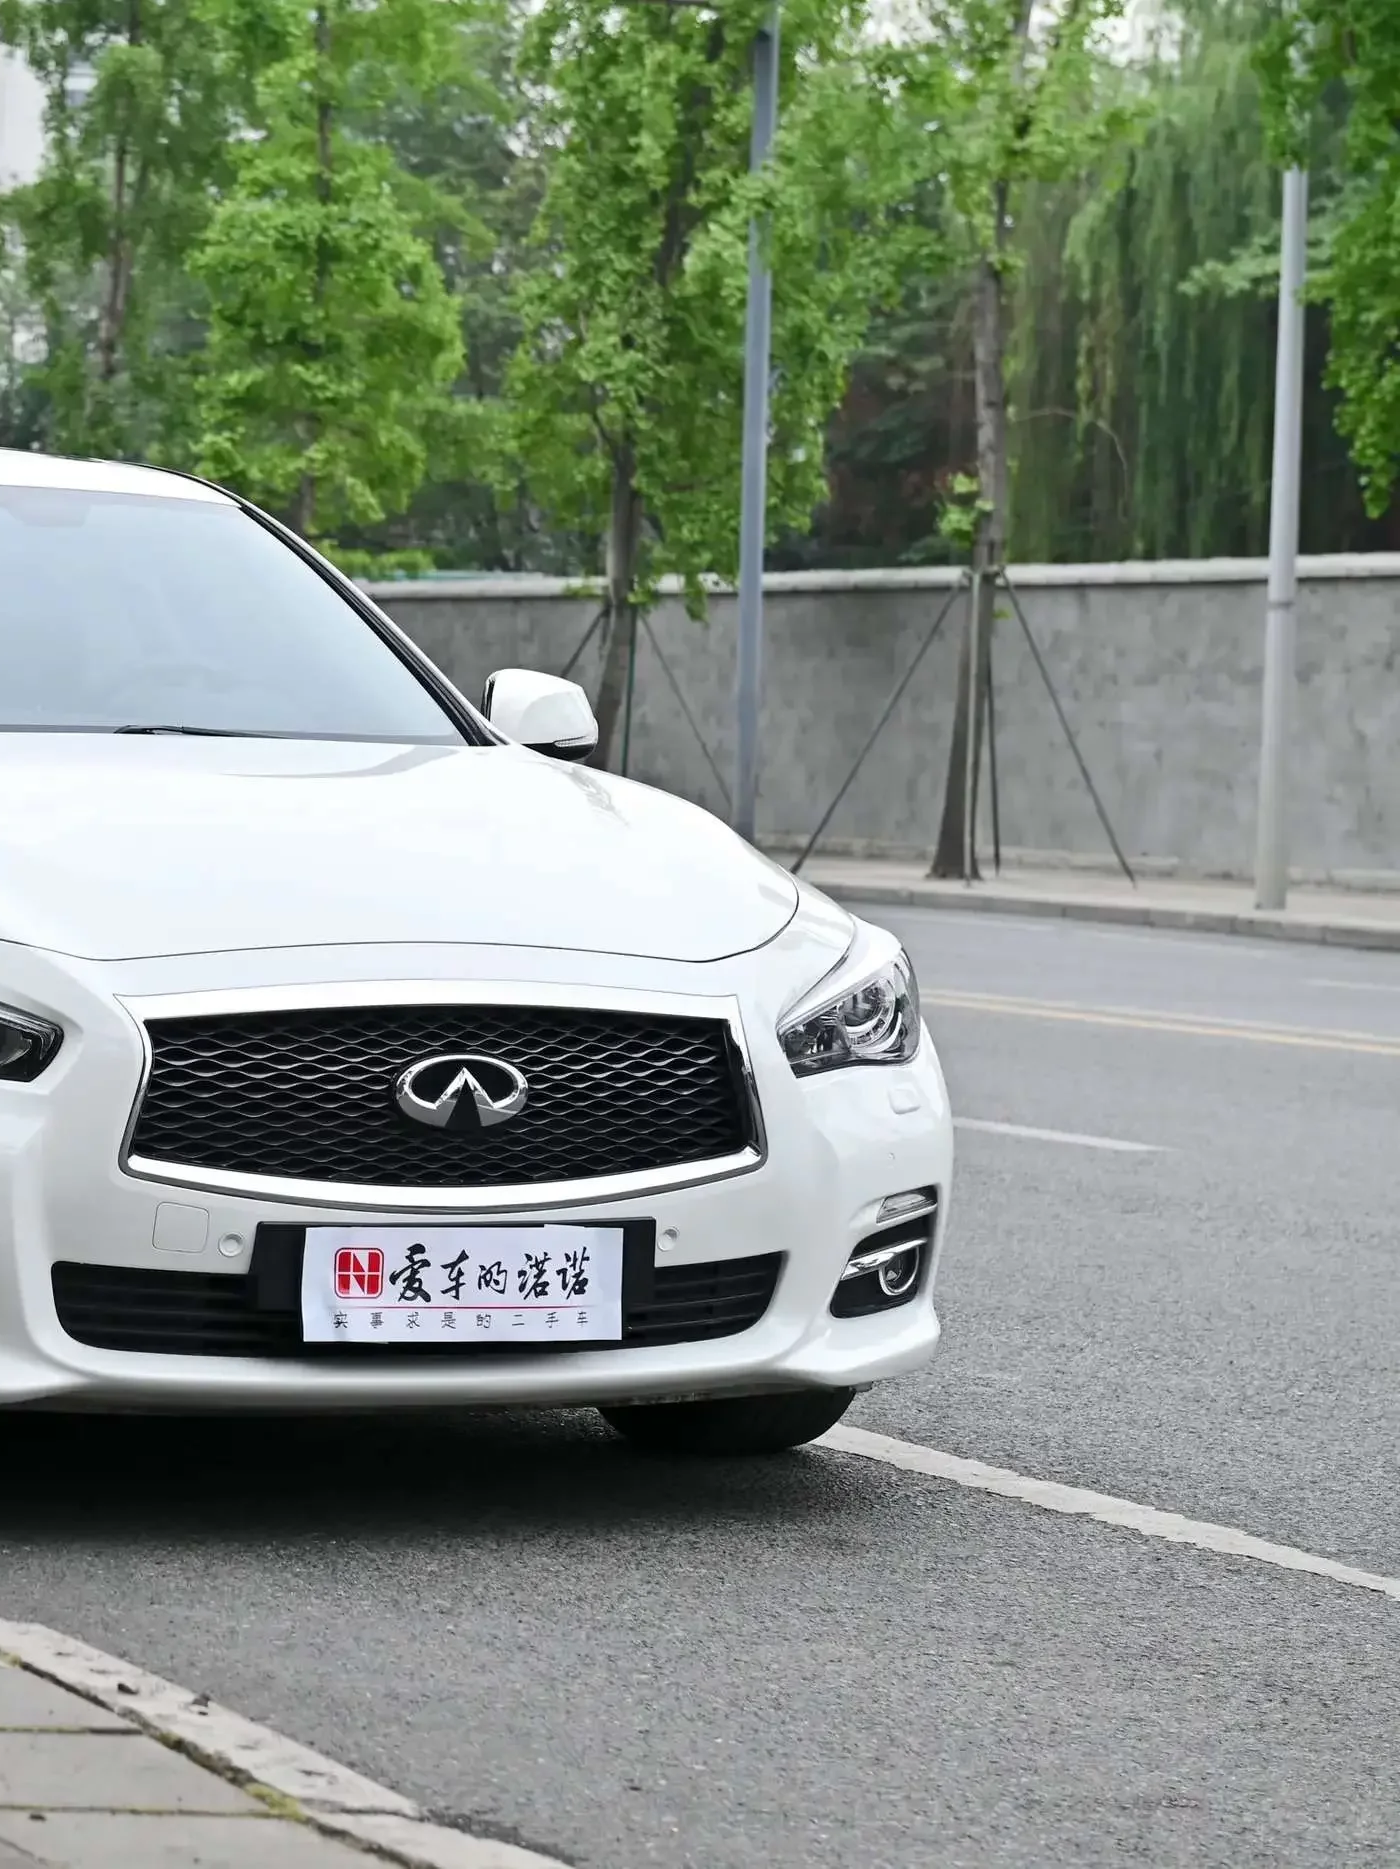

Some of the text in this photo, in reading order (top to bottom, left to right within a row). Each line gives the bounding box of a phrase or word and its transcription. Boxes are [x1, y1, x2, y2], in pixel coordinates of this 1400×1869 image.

[332, 1310, 589, 1329] 实事求是的二手车
